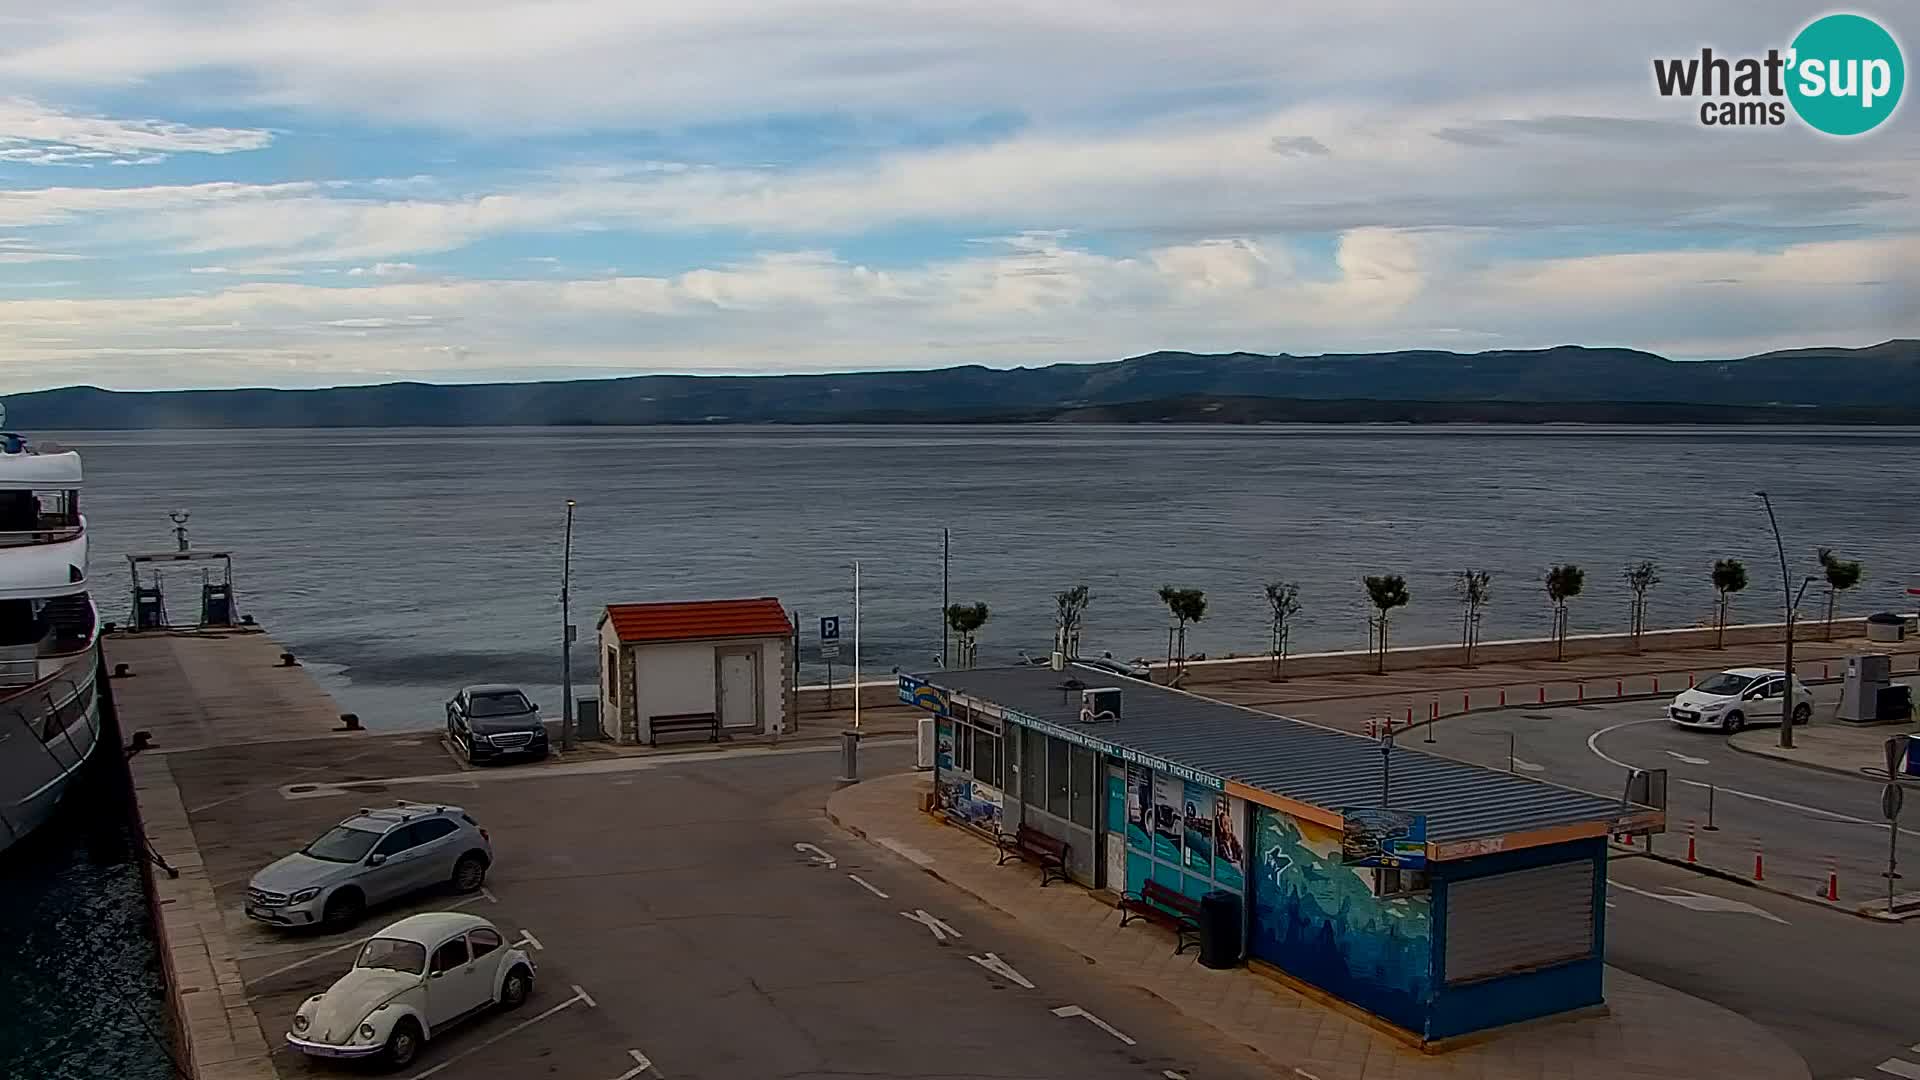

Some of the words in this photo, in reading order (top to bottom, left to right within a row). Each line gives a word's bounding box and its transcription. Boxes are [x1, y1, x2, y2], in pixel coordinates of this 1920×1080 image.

[825, 620, 836, 636] P
[1084, 737, 1113, 755] POSTAJA
[1122, 749, 1136, 761] BUS
[1137, 754, 1167, 772] STATION
[1169, 764, 1194, 781] TICKET
[1194, 773, 1221, 789] OFFICE
[793, 843, 1187, 1080] LAKIĆ
